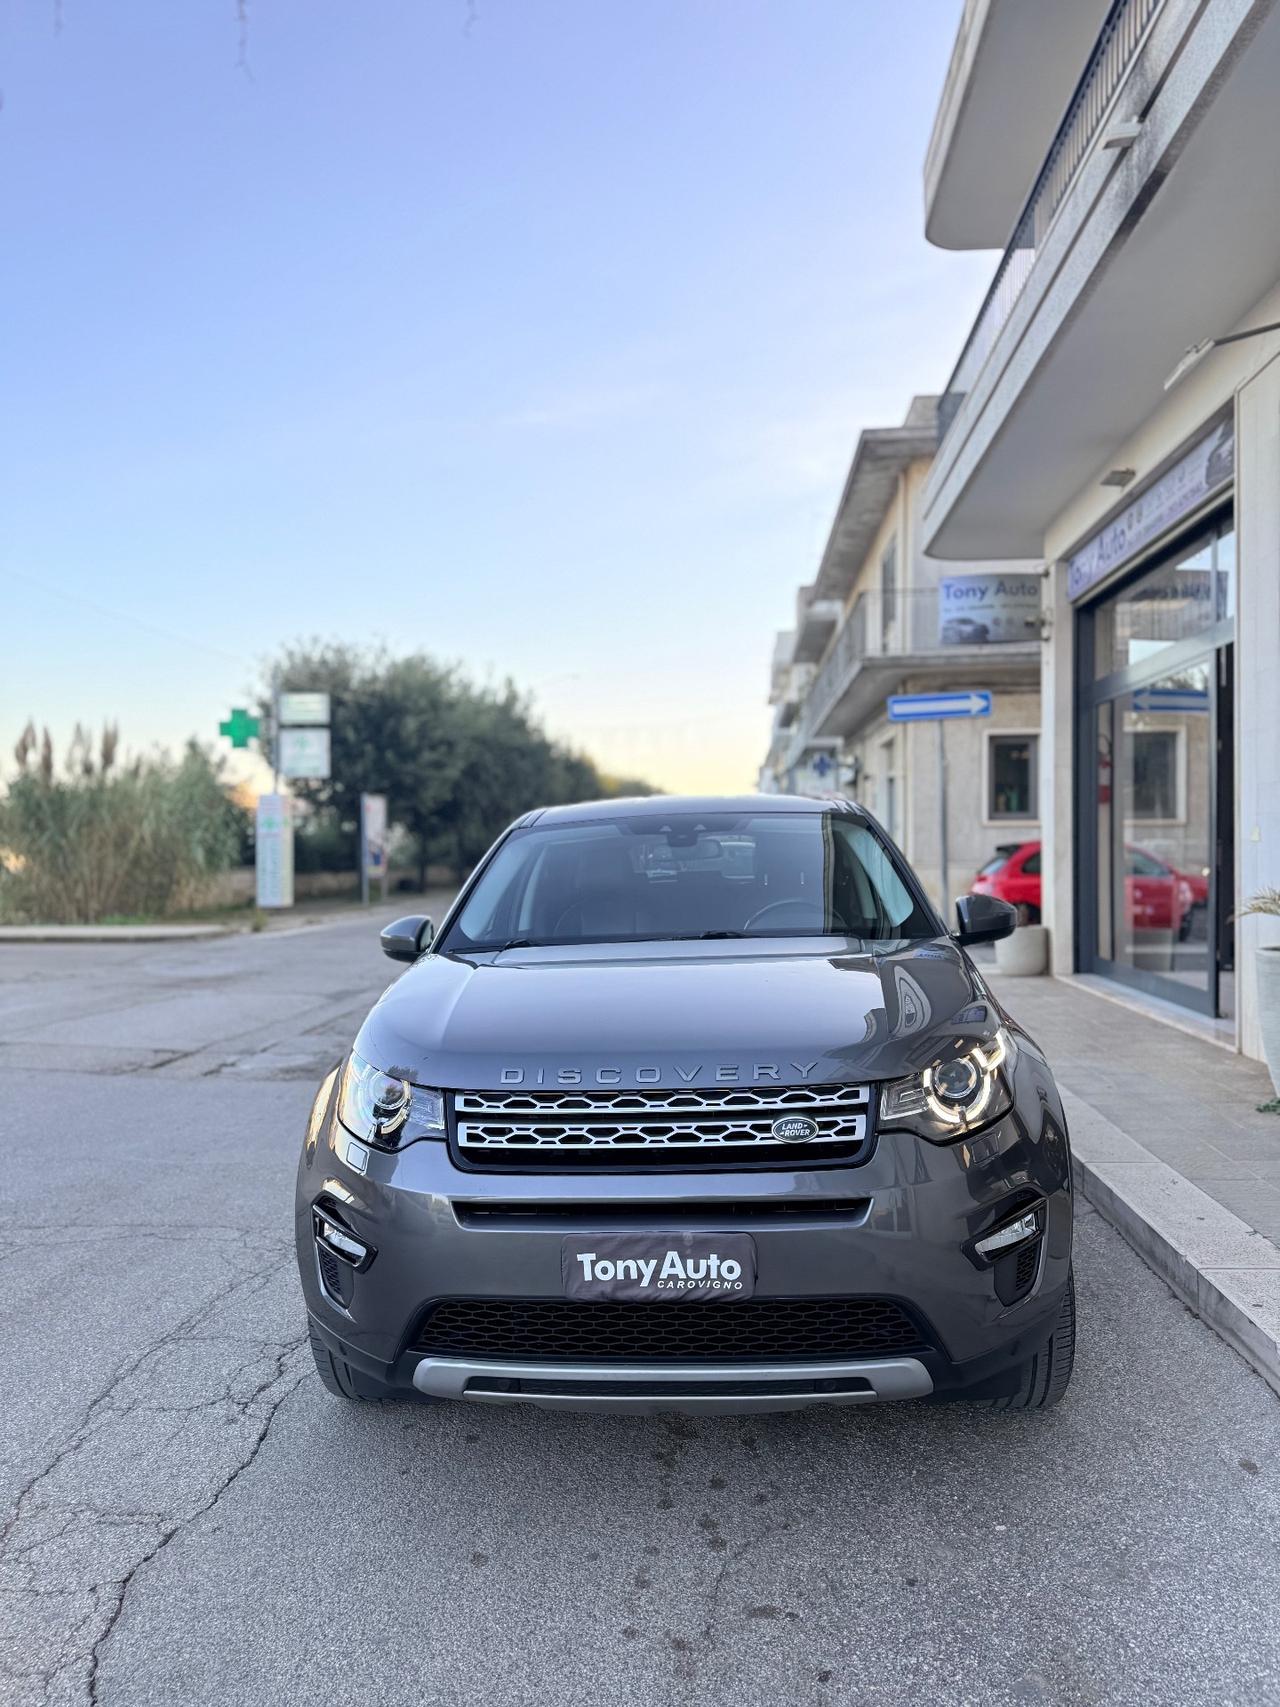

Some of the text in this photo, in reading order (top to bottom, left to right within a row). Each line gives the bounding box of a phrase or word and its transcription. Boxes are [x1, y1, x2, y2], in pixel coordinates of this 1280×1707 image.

[1098, 526, 1127, 562] Auto
[943, 580, 1039, 602] Tony Auto
[500, 1062, 819, 1084] DISCOVERY
[782, 1122, 803, 1130] LAND
[784, 1129, 811, 1137] ROVER
[657, 1280, 743, 1290] CAROVIGNO
